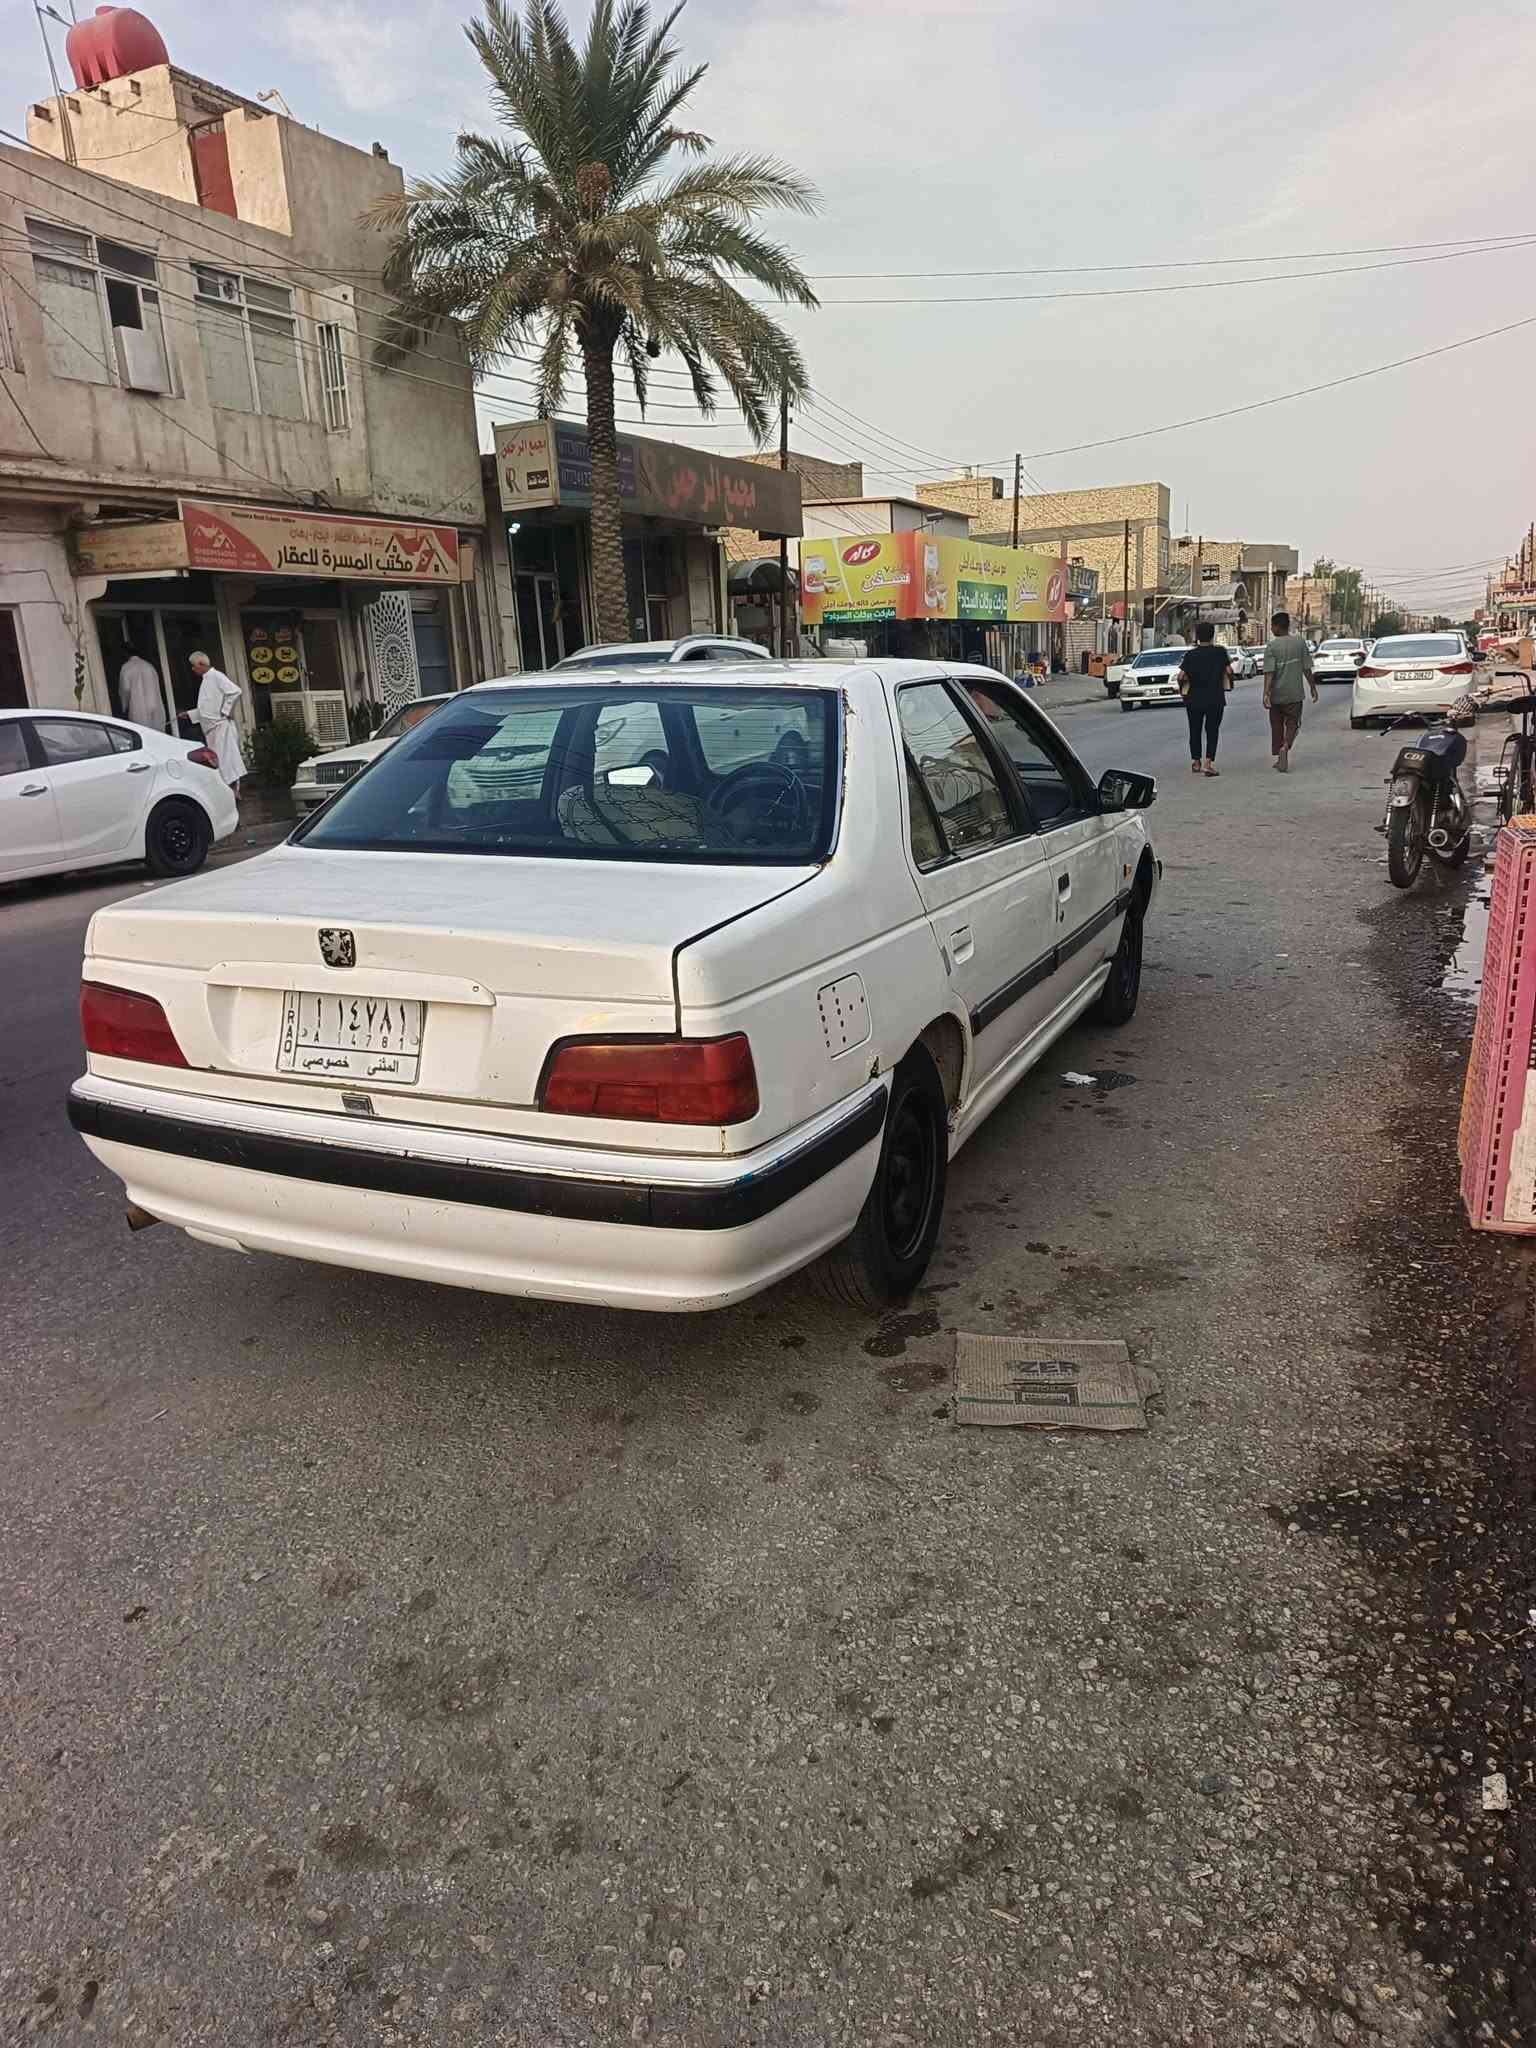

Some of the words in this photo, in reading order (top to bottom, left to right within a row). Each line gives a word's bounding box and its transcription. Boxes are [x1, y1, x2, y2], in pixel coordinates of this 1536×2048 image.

[277, 545, 319, 569] للعقار
[322, 549, 373, 572] المسرة
[376, 553, 413, 575] مكتب
[1404, 752, 1425, 761] CDI
[284, 994, 295, 1053] IRAQ
[302, 1056, 349, 1070] خصوصي
